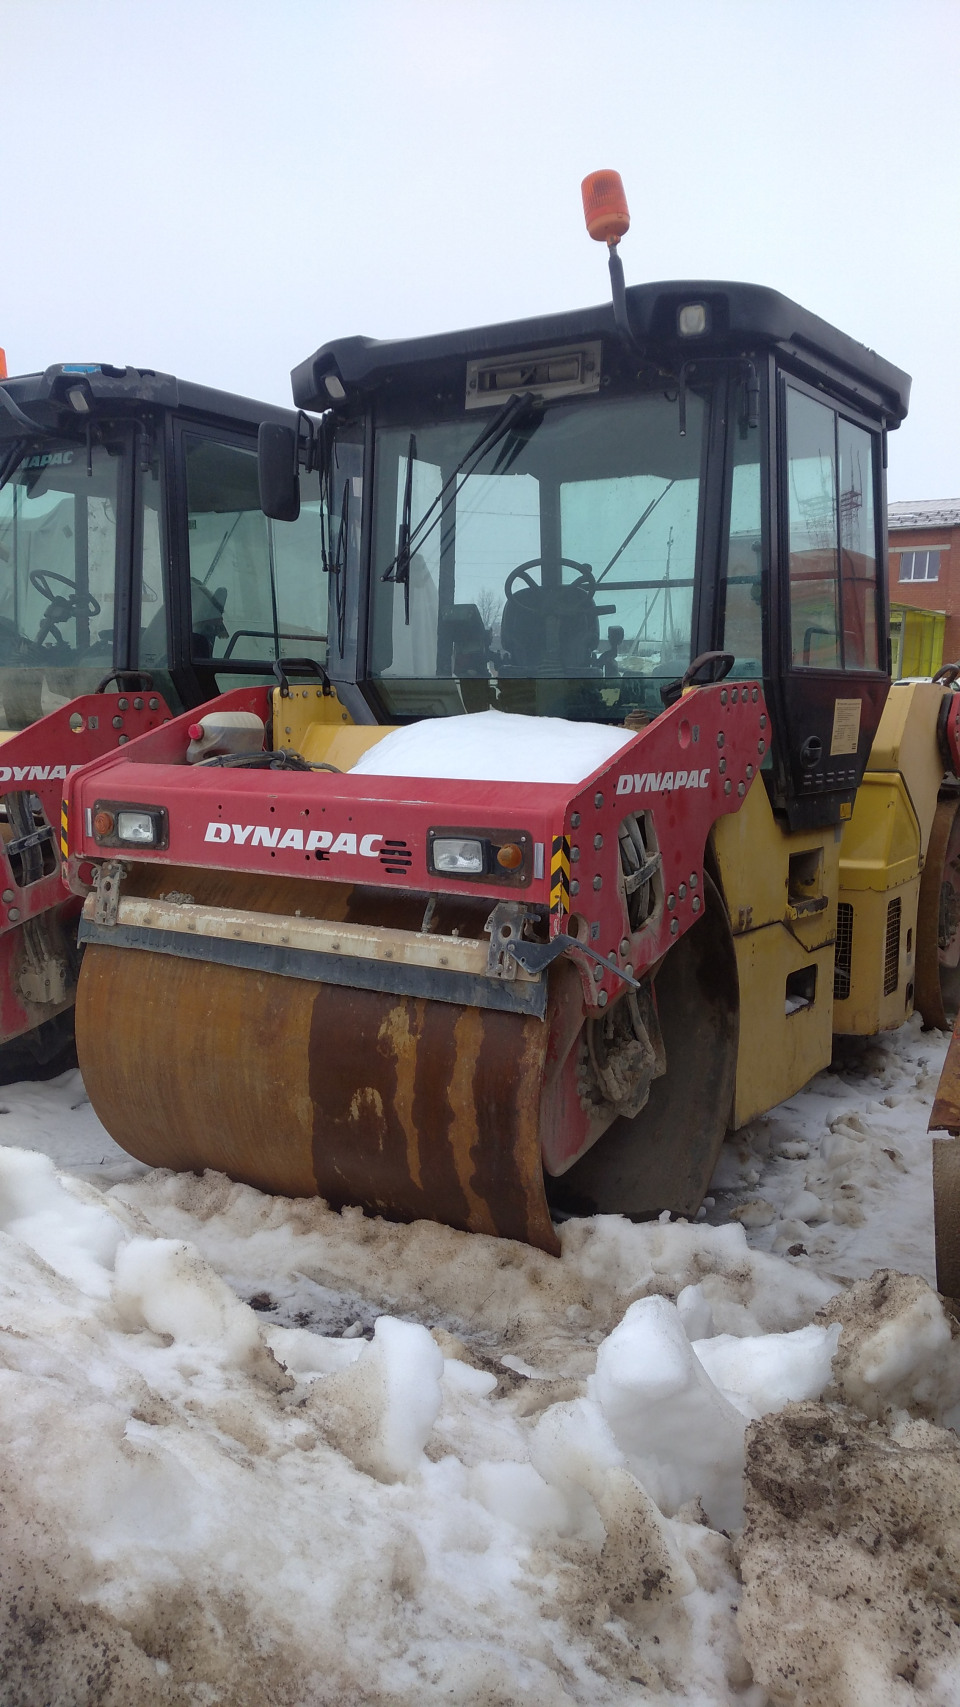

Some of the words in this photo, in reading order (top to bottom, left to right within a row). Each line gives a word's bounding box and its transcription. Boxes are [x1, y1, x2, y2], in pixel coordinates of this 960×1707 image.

[20, 451, 74, 468] NAPAC
[0, 765, 85, 782] DYNA
[616, 768, 711, 795] DYNAPAC
[204, 822, 384, 857] DYNAPAC
